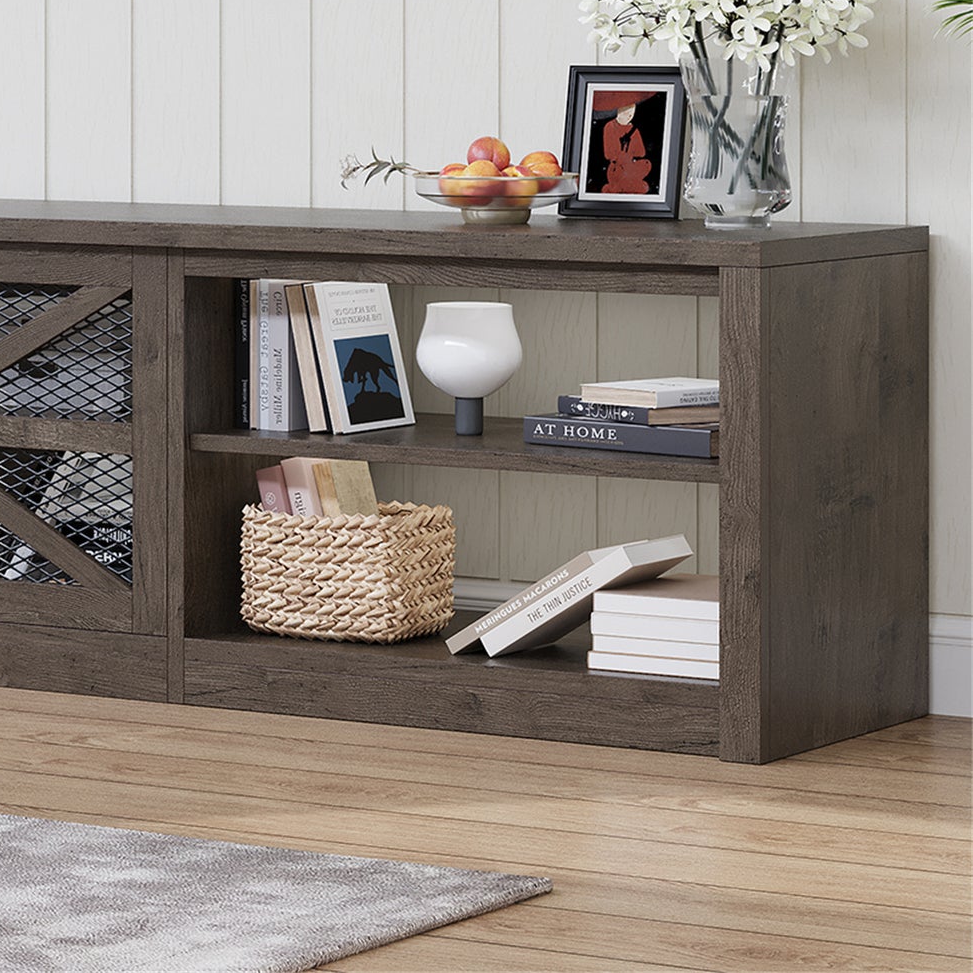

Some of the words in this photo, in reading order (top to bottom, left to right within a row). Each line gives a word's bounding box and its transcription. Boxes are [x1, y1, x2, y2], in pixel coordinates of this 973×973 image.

[533, 424, 556, 435] AT
[563, 425, 617, 440] HOME
[474, 601, 522, 634] MERINGUES
[523, 569, 570, 602] MACARONS
[527, 607, 544, 624] THE
[543, 596, 563, 614] THIN
[563, 576, 593, 603] JUSTICE
